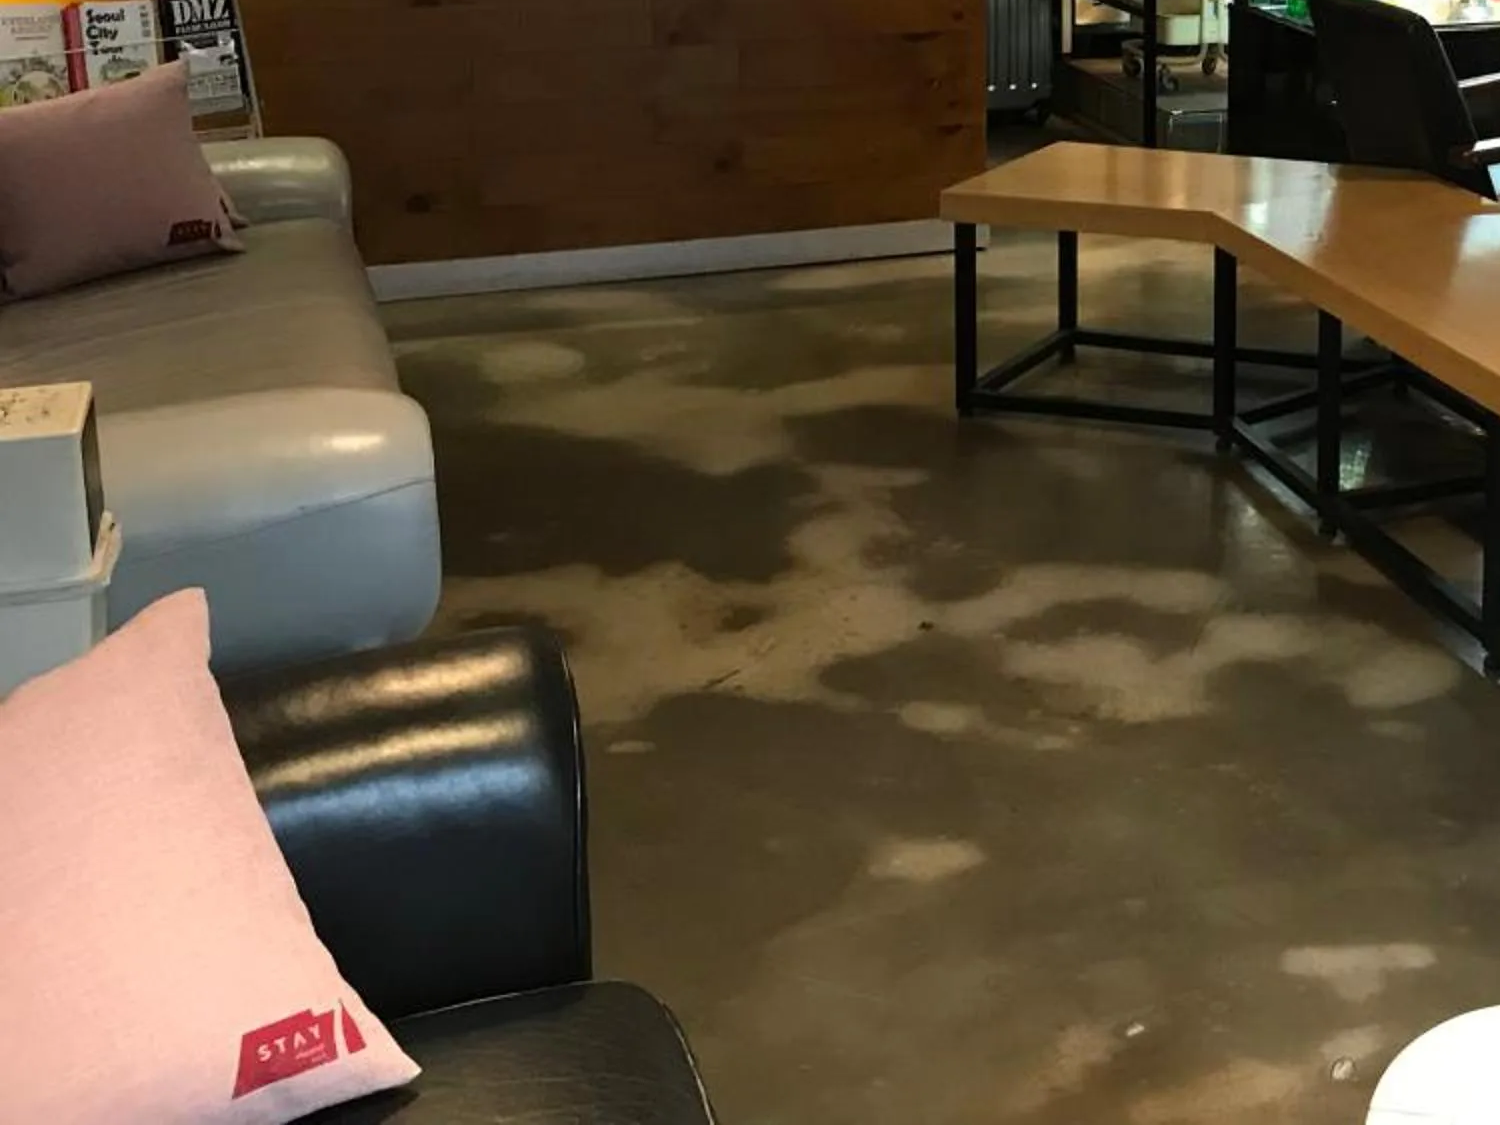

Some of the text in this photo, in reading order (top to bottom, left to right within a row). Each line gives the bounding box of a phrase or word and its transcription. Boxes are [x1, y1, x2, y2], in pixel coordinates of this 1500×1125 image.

[86, 8, 125, 24] Seoul
[86, 25, 119, 41] City
[256, 1022, 321, 1062] STAY
